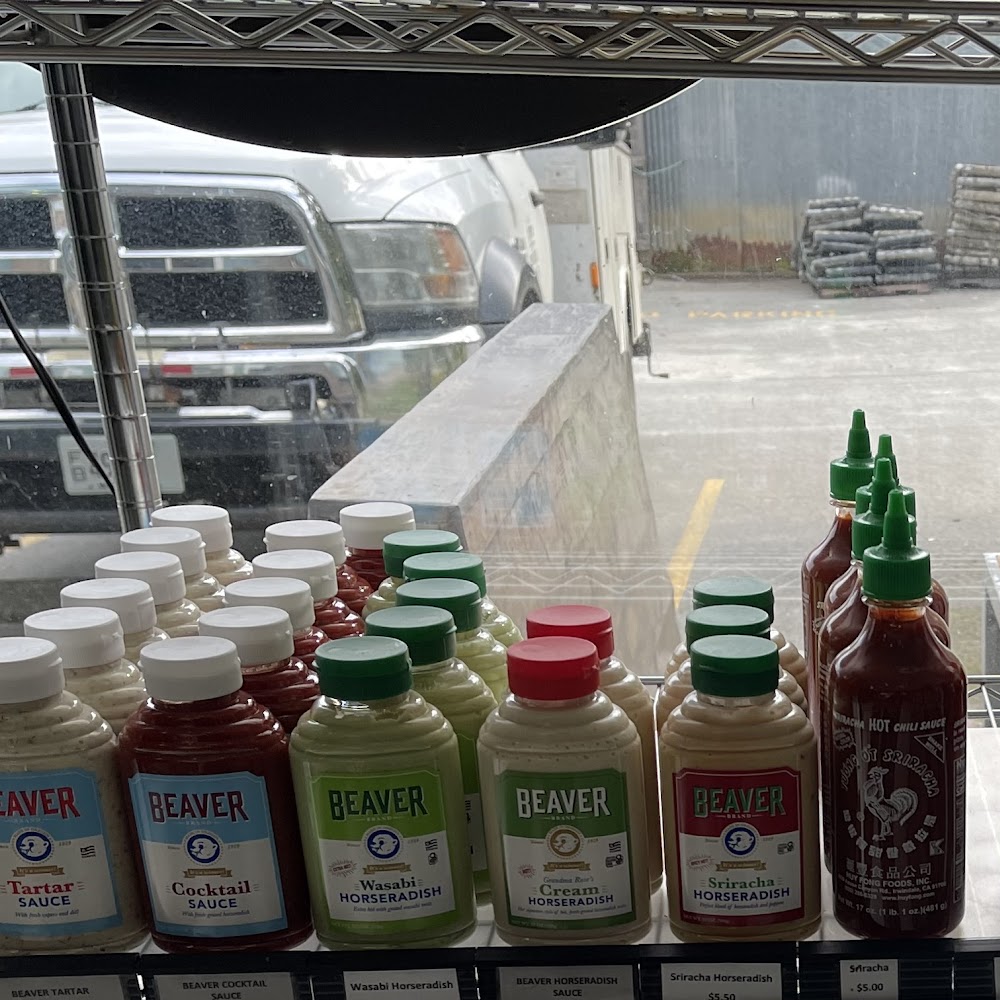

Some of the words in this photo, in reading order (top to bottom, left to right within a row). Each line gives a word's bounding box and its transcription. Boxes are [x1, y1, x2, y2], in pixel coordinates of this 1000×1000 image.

[869, 718, 890, 732] HOT
[893, 722, 918, 732] CHILI
[920, 717, 946, 731] SAUCE
[883, 748, 940, 798] SRIRACHA
[148, 790, 249, 823] BEAVER
[328, 785, 428, 821] BEAVER
[516, 786, 611, 819] BEAVER
[693, 786, 786, 818] BEAVER
[7, 881, 75, 895] Tartar
[171, 880, 251, 897] Cocktail
[360, 876, 417, 891] Wasabi
[708, 876, 775, 889] Sriracha
[859, 878, 881, 887] FONG
[339, 886, 442, 904] HORSERADISH
[539, 884, 600, 897] Cream
[693, 887, 790, 902] HORSERADISH
[18, 895, 71, 907] SAUCE
[188, 898, 238, 909] SAUCE
[528, 894, 614, 906] HORSERADISH
[856, 903, 864, 911] 17
[889, 908, 900, 916] lb.
[849, 963, 889, 973] Sriracha
[516, 977, 551, 985] BEAVER
[554, 976, 618, 985] HORSERADISH
[670, 973, 711, 982] Sriracha
[713, 973, 773, 983] Horseradish
[182, 981, 219, 990] BEAVER
[222, 980, 267, 988] COCKTAIL
[350, 982, 389, 991] Wasabi
[392, 980, 454, 991] Horseradish
[856, 983, 884, 993] $5.00
[11, 989, 49, 998] BEAVER
[50, 987, 90, 997] TARTAR
[211, 992, 242, 1000] SAUCE
[553, 989, 582, 997] SAUCE
